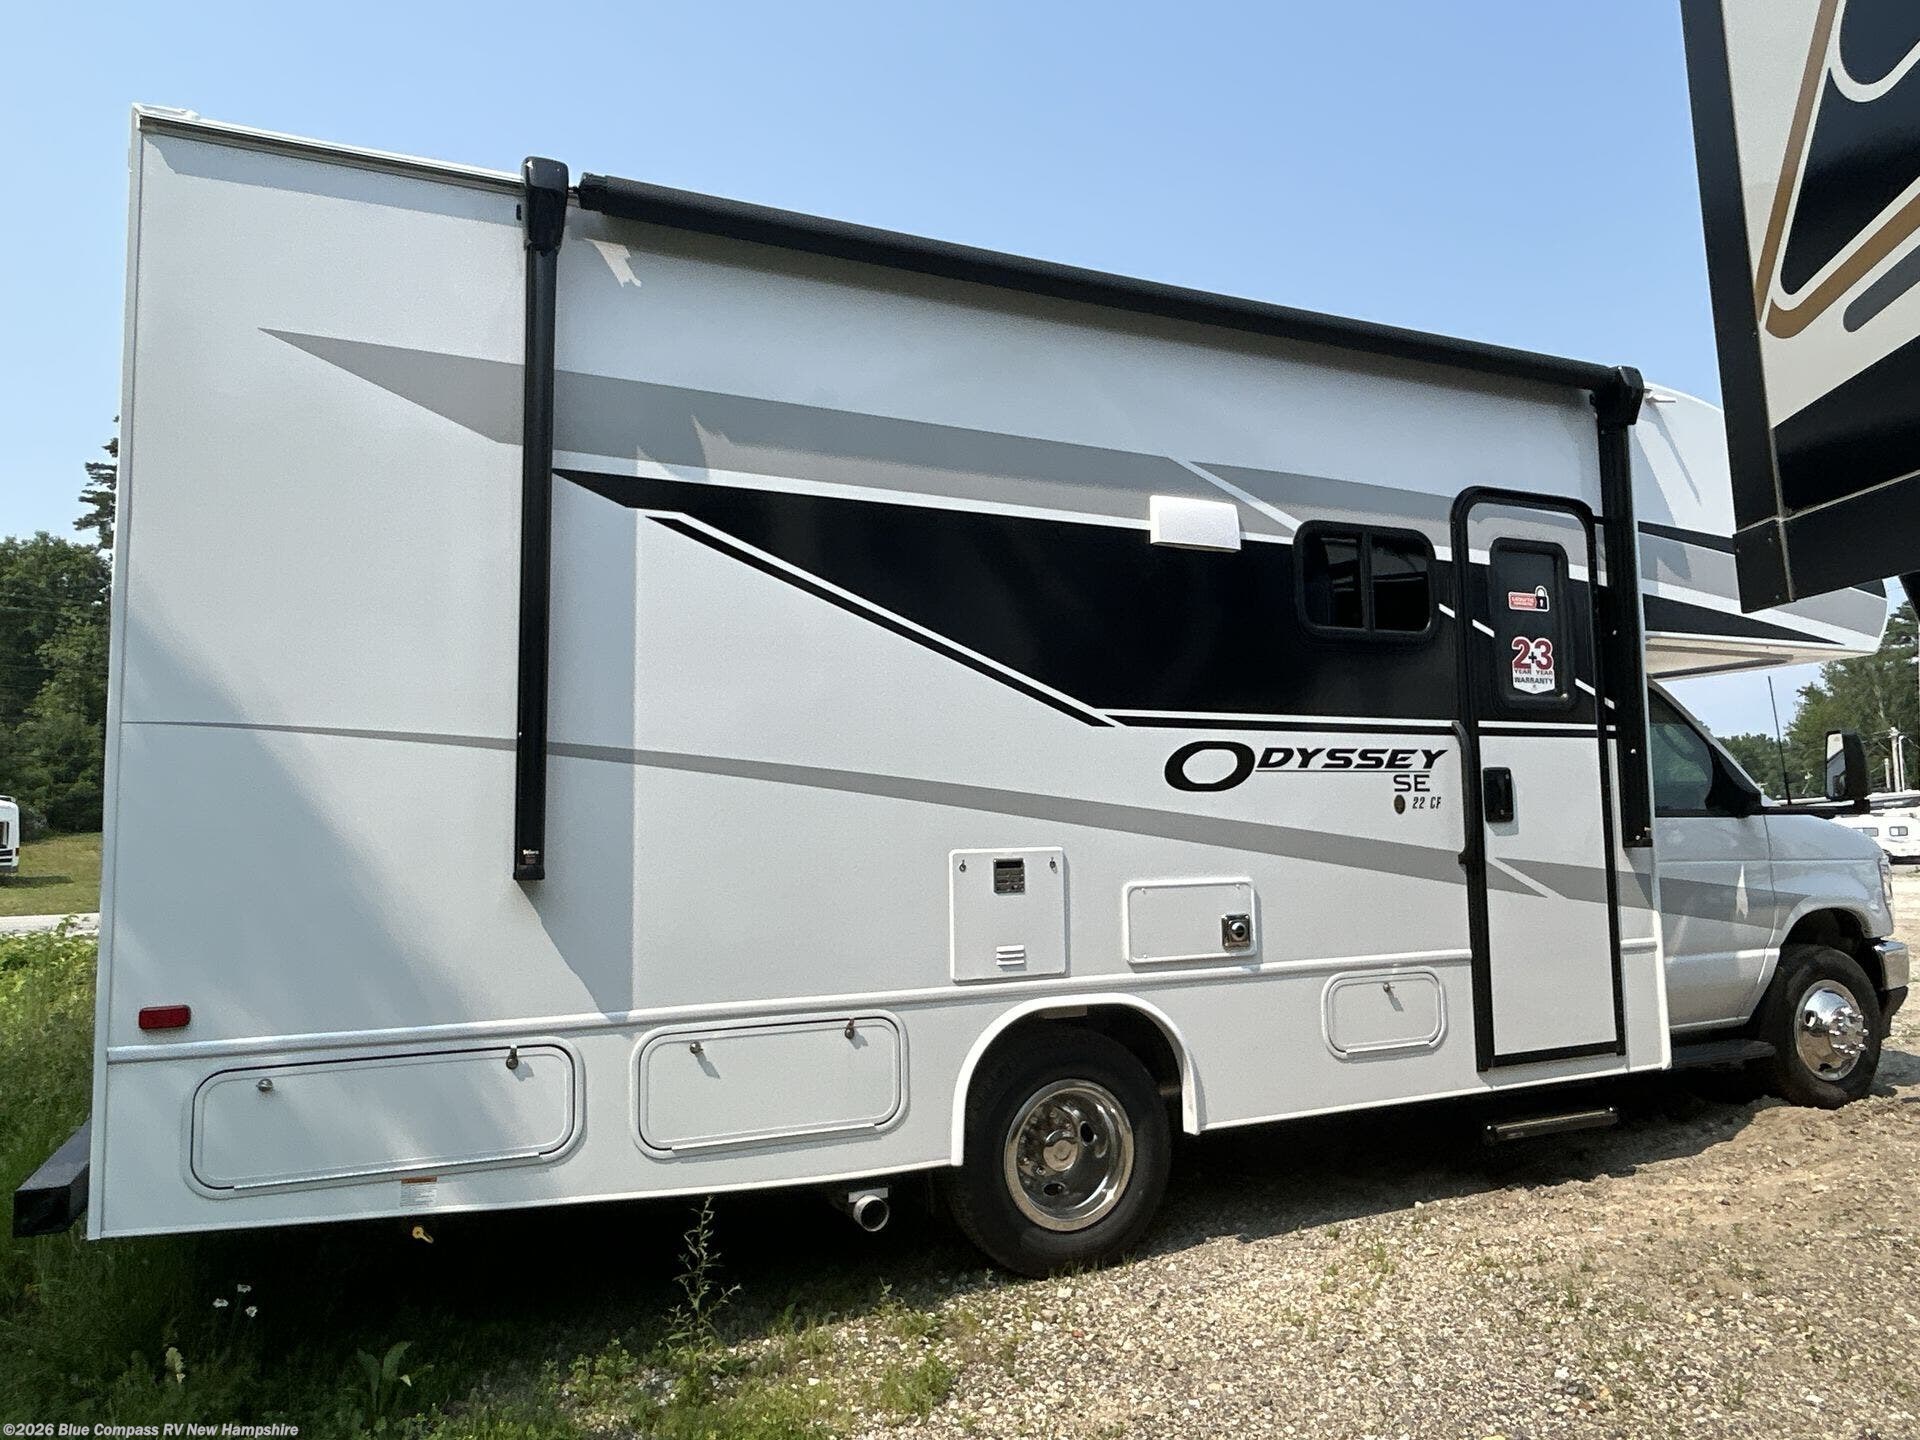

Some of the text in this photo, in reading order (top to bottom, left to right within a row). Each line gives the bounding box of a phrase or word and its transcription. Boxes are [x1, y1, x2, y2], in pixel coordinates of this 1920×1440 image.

[1164, 740, 1448, 793] ODYSSEY
[1393, 774, 1430, 793] SE
[1412, 796, 1442, 810] 22 CF
